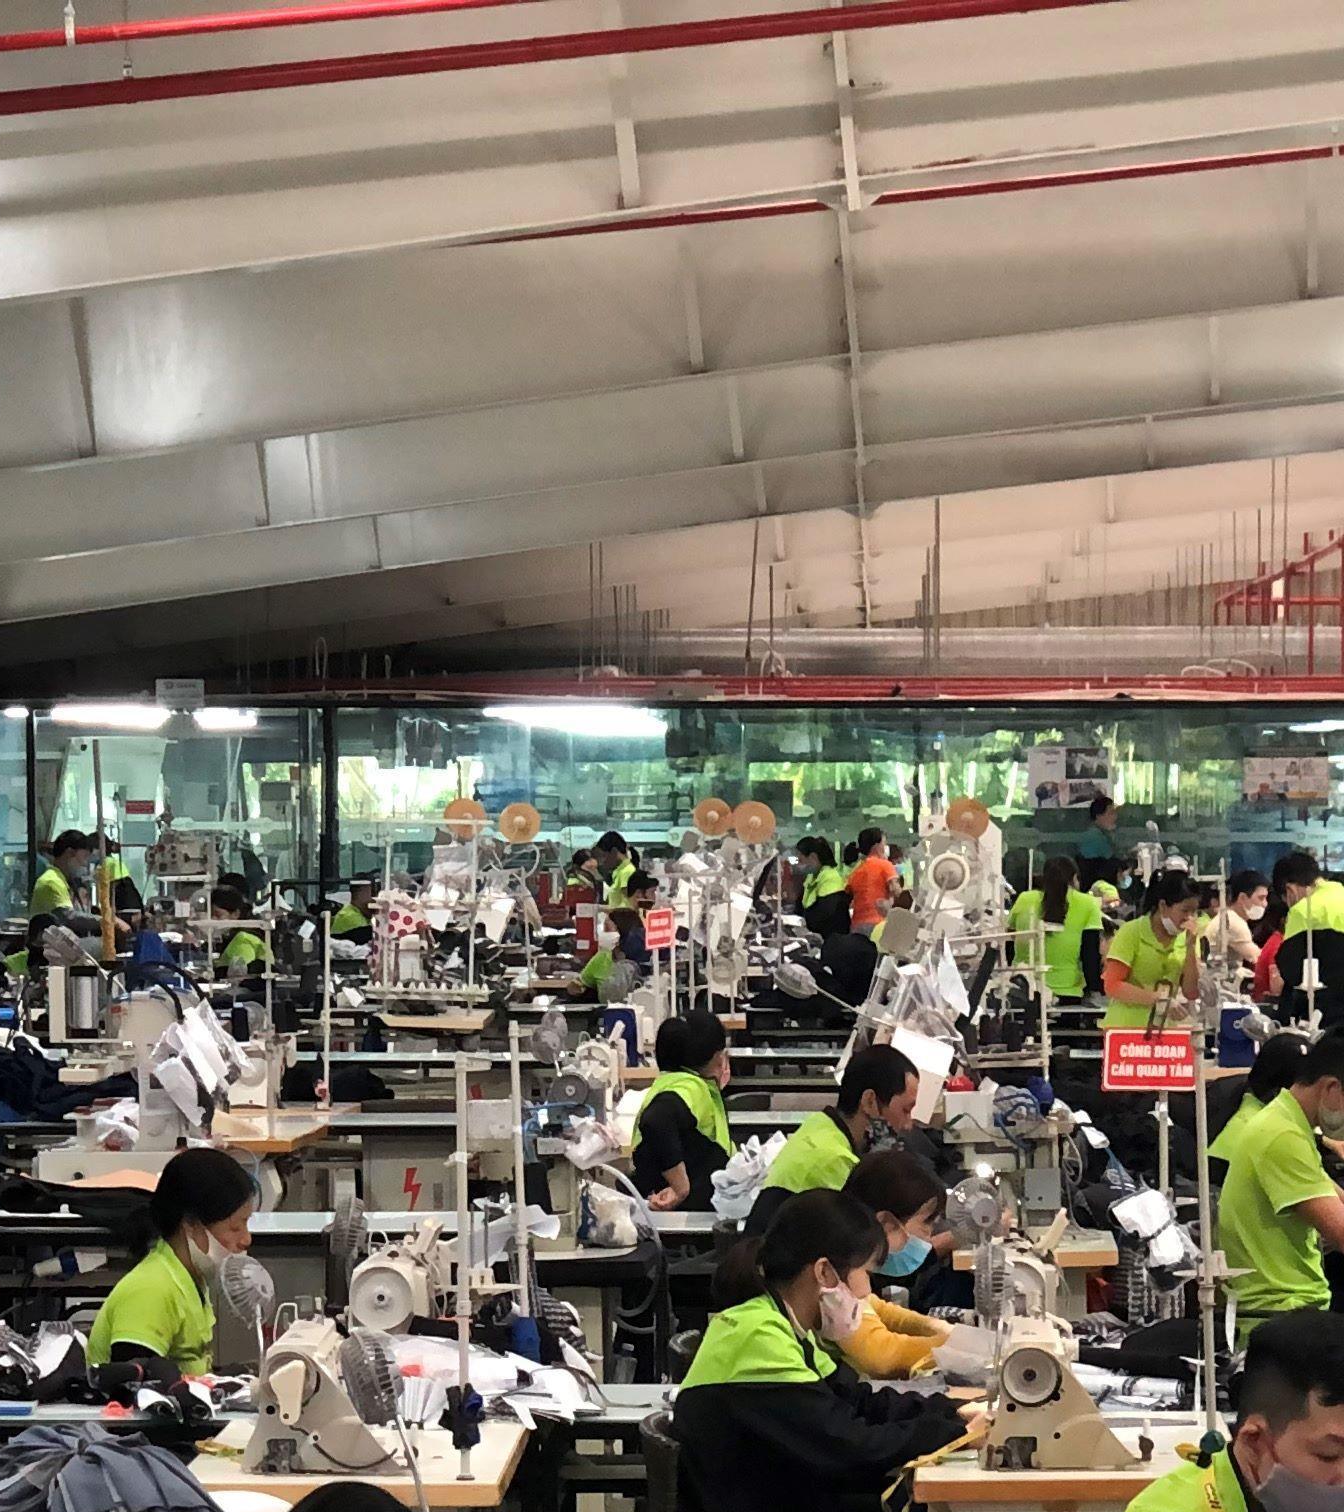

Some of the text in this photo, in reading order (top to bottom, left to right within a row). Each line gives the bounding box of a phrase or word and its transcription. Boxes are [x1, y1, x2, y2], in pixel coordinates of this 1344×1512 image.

[1119, 1042, 1152, 1058] CÔNG
[1111, 1060, 1194, 1078] CẦN QUAN TÂM
